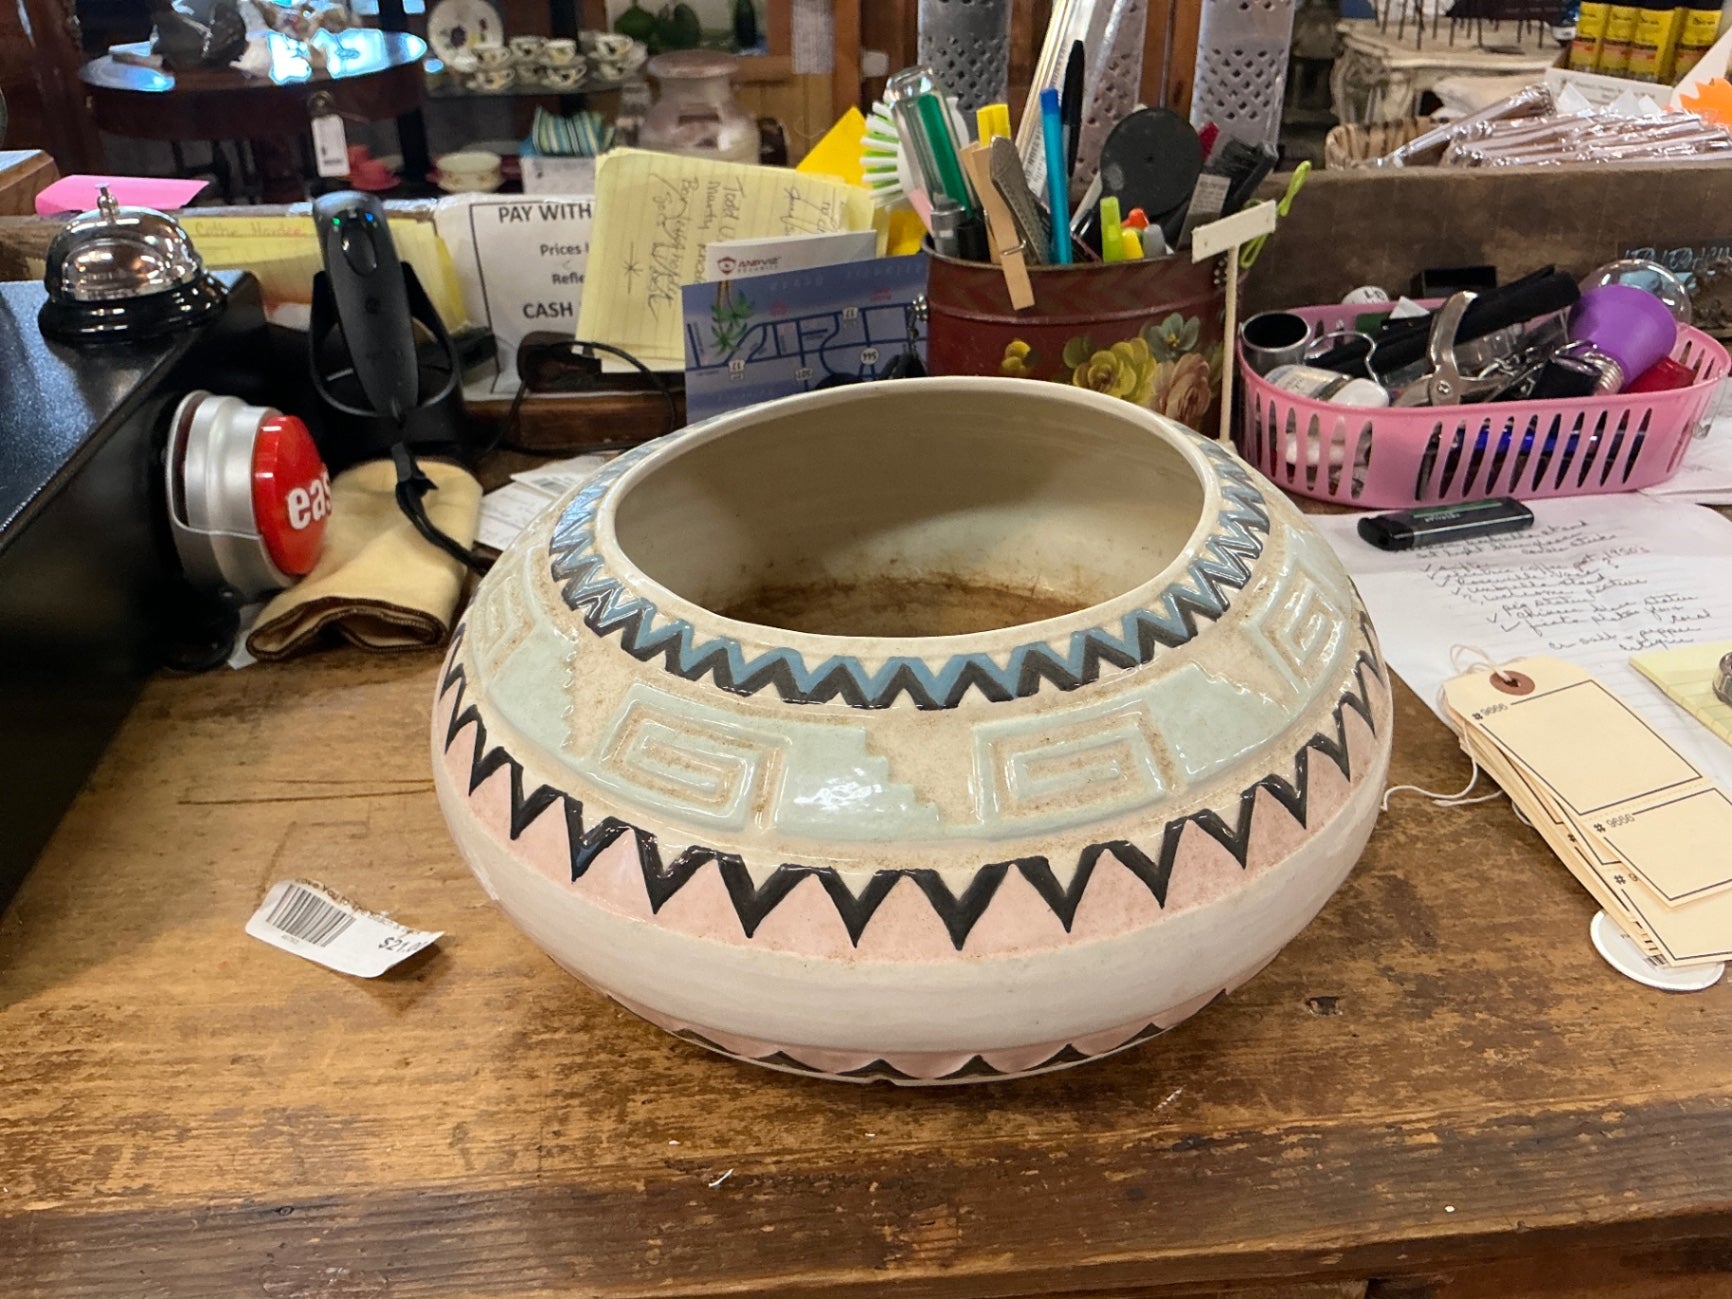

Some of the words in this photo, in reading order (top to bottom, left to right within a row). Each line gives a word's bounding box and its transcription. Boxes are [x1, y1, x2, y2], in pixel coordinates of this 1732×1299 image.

[498, 205, 532, 223] PAY
[539, 203, 592, 221] WITH
[540, 242, 582, 256] Prices
[522, 301, 574, 319] CASH
